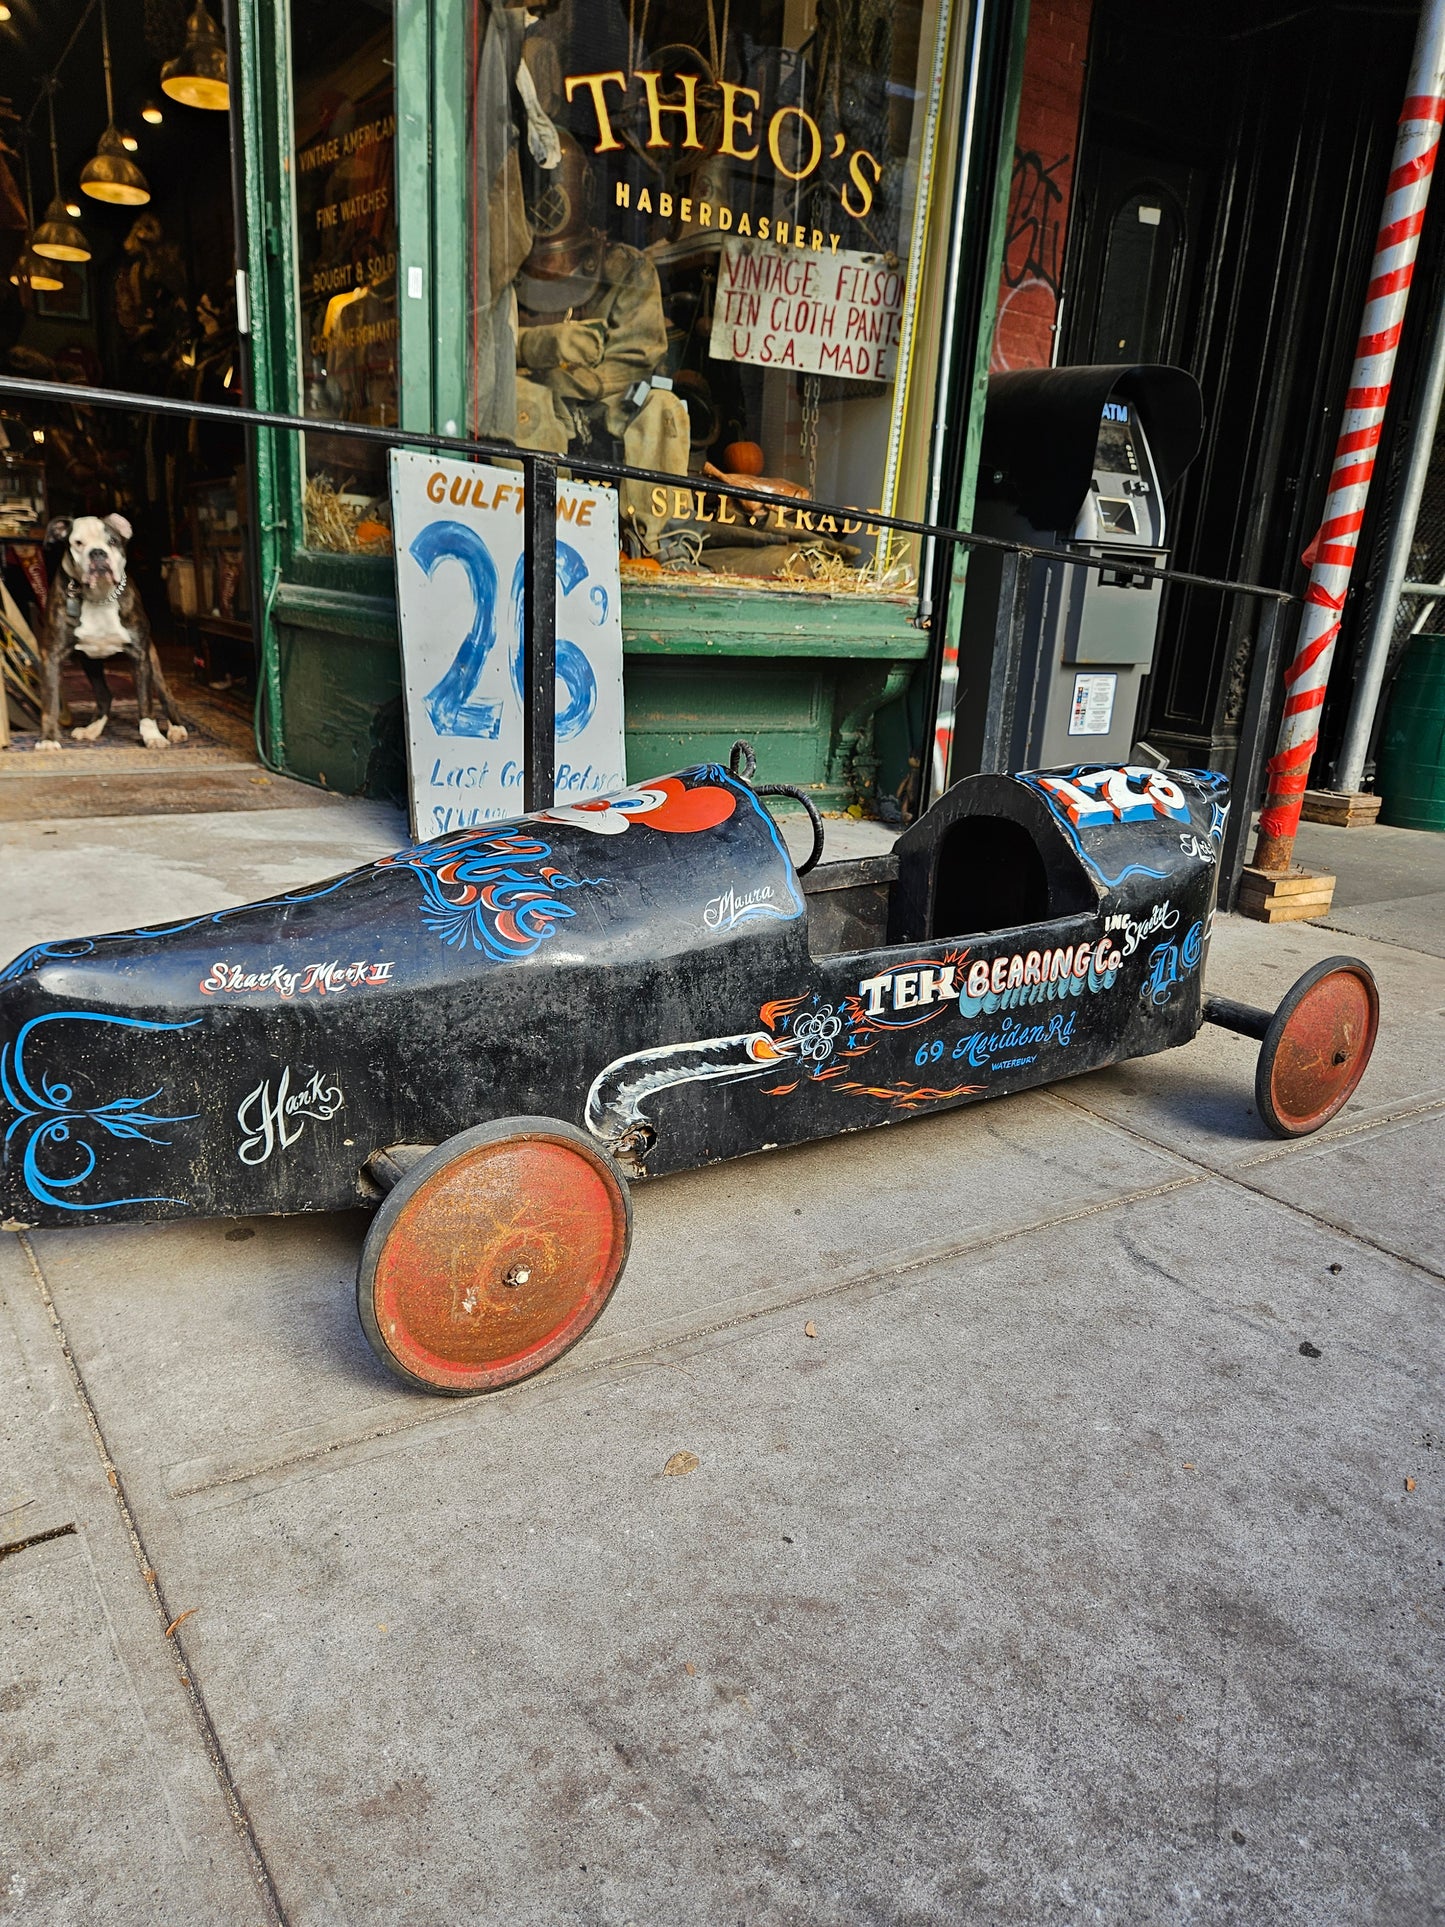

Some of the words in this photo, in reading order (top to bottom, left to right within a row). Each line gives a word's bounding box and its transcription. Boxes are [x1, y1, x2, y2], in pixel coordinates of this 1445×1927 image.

[300, 138, 339, 172] VINTAGE
[343, 115, 395, 156] AMERICAN
[564, 70, 882, 218] THEO'S
[316, 203, 338, 230] FINE
[340, 187, 389, 222] WATCHES
[615, 181, 841, 256] HABERDASHERY
[312, 264, 352, 294] BOUGHT
[355, 261, 364, 282] &
[367, 253, 396, 279] SOLD
[725, 251, 817, 298] VINTAGE
[724, 290, 761, 327] TIN
[770, 297, 837, 338] CLOTH
[732, 330, 804, 368] U.S.A.
[818, 341, 887, 379] MADE
[1102, 403, 1128, 422] ATM
[426, 471, 597, 528] GULFTNE
[651, 486, 736, 525] SELL
[409, 520, 598, 744] 26
[430, 758, 490, 789] Last
[300, 960, 369, 995] Mark
[368, 961, 396, 985] II
[859, 966, 960, 1017] TEK
[965, 942, 1091, 1002] BEARING
[914, 1039, 945, 1067] 69
[952, 1017, 1046, 1067] Meriden
[991, 1052, 1039, 1072] WATERBURY
[237, 1065, 344, 1166] Hank
